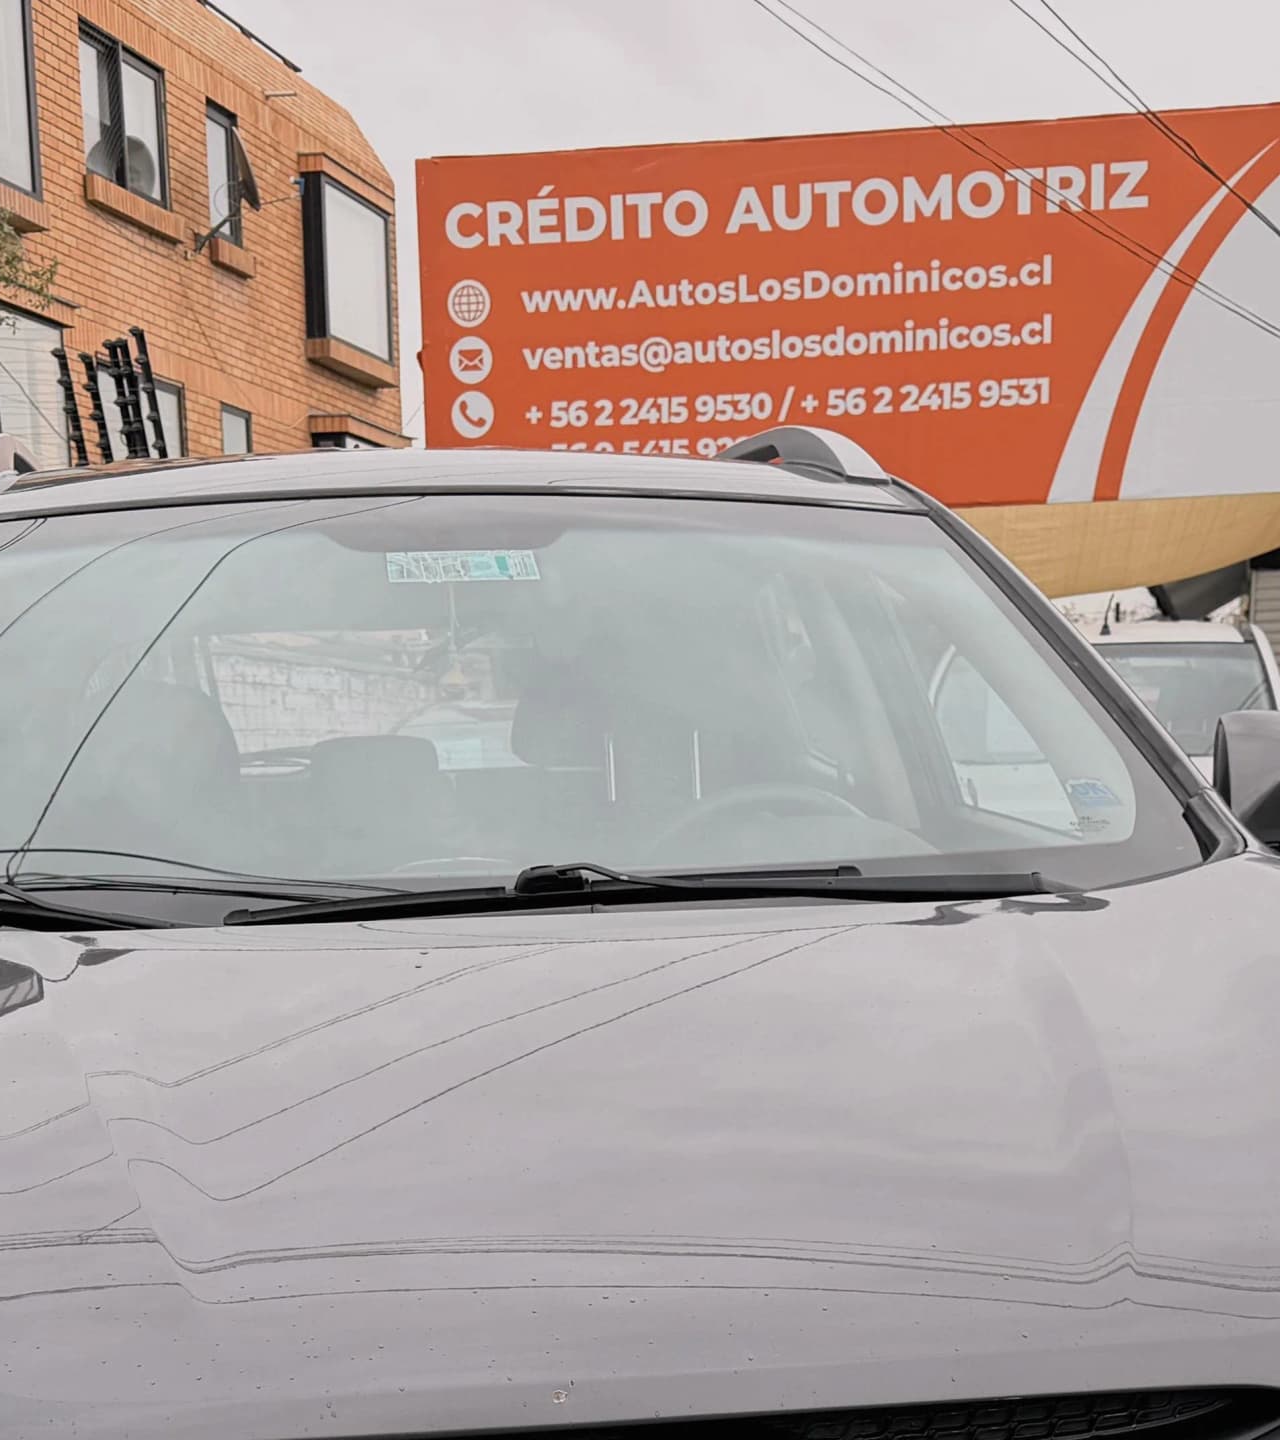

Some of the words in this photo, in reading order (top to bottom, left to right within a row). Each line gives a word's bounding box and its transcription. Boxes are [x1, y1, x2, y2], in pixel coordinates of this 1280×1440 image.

[444, 185, 709, 249] CRÉDITO
[725, 160, 1150, 234] AUTOMOTRIZ
[520, 255, 1053, 313] www.AutosLosDominicos.cl
[522, 314, 1053, 373] ventas@autoslosdominicos.cl
[549, 399, 589, 428] 56
[593, 398, 614, 427] 2
[619, 395, 689, 426] 2415
[694, 391, 774, 423] 9530
[826, 386, 867, 417] 56
[872, 385, 894, 414] 2
[899, 380, 973, 413] 2415
[978, 376, 1050, 409] 9531
